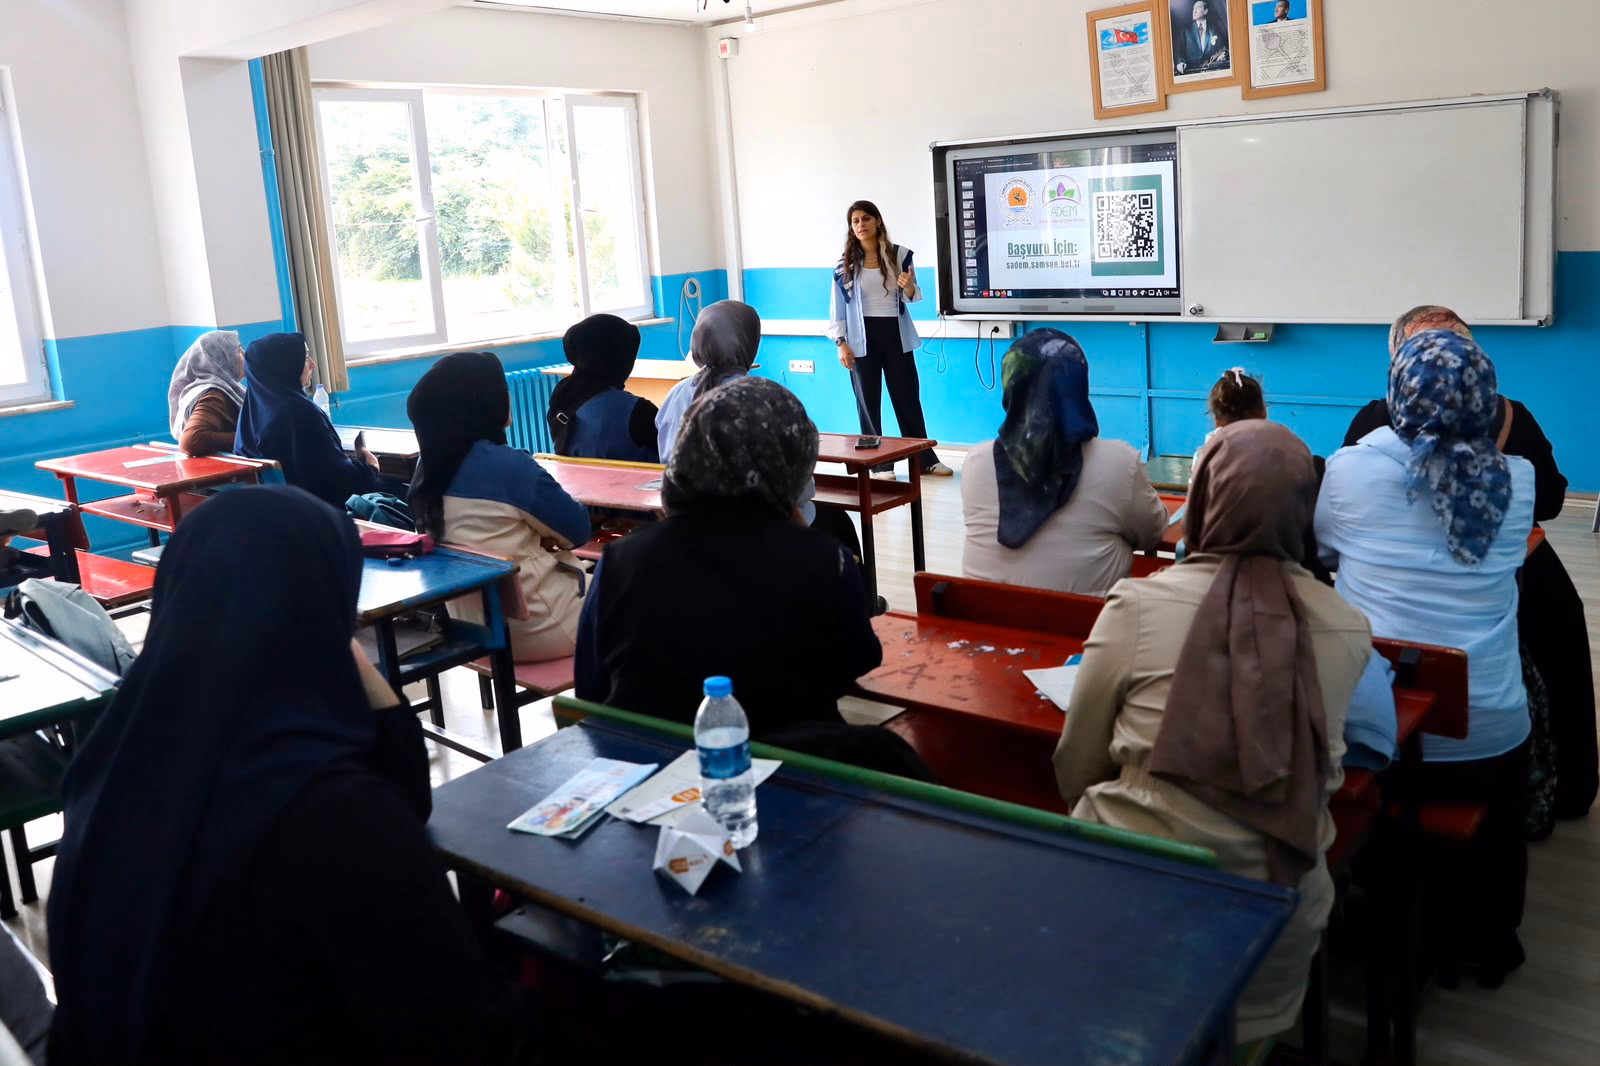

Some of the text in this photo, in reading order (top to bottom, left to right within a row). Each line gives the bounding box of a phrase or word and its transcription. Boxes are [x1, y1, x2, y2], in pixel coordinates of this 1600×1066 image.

[1048, 206, 1078, 218] ADEM
[1007, 238, 1077, 259] Başvuru İçin:
